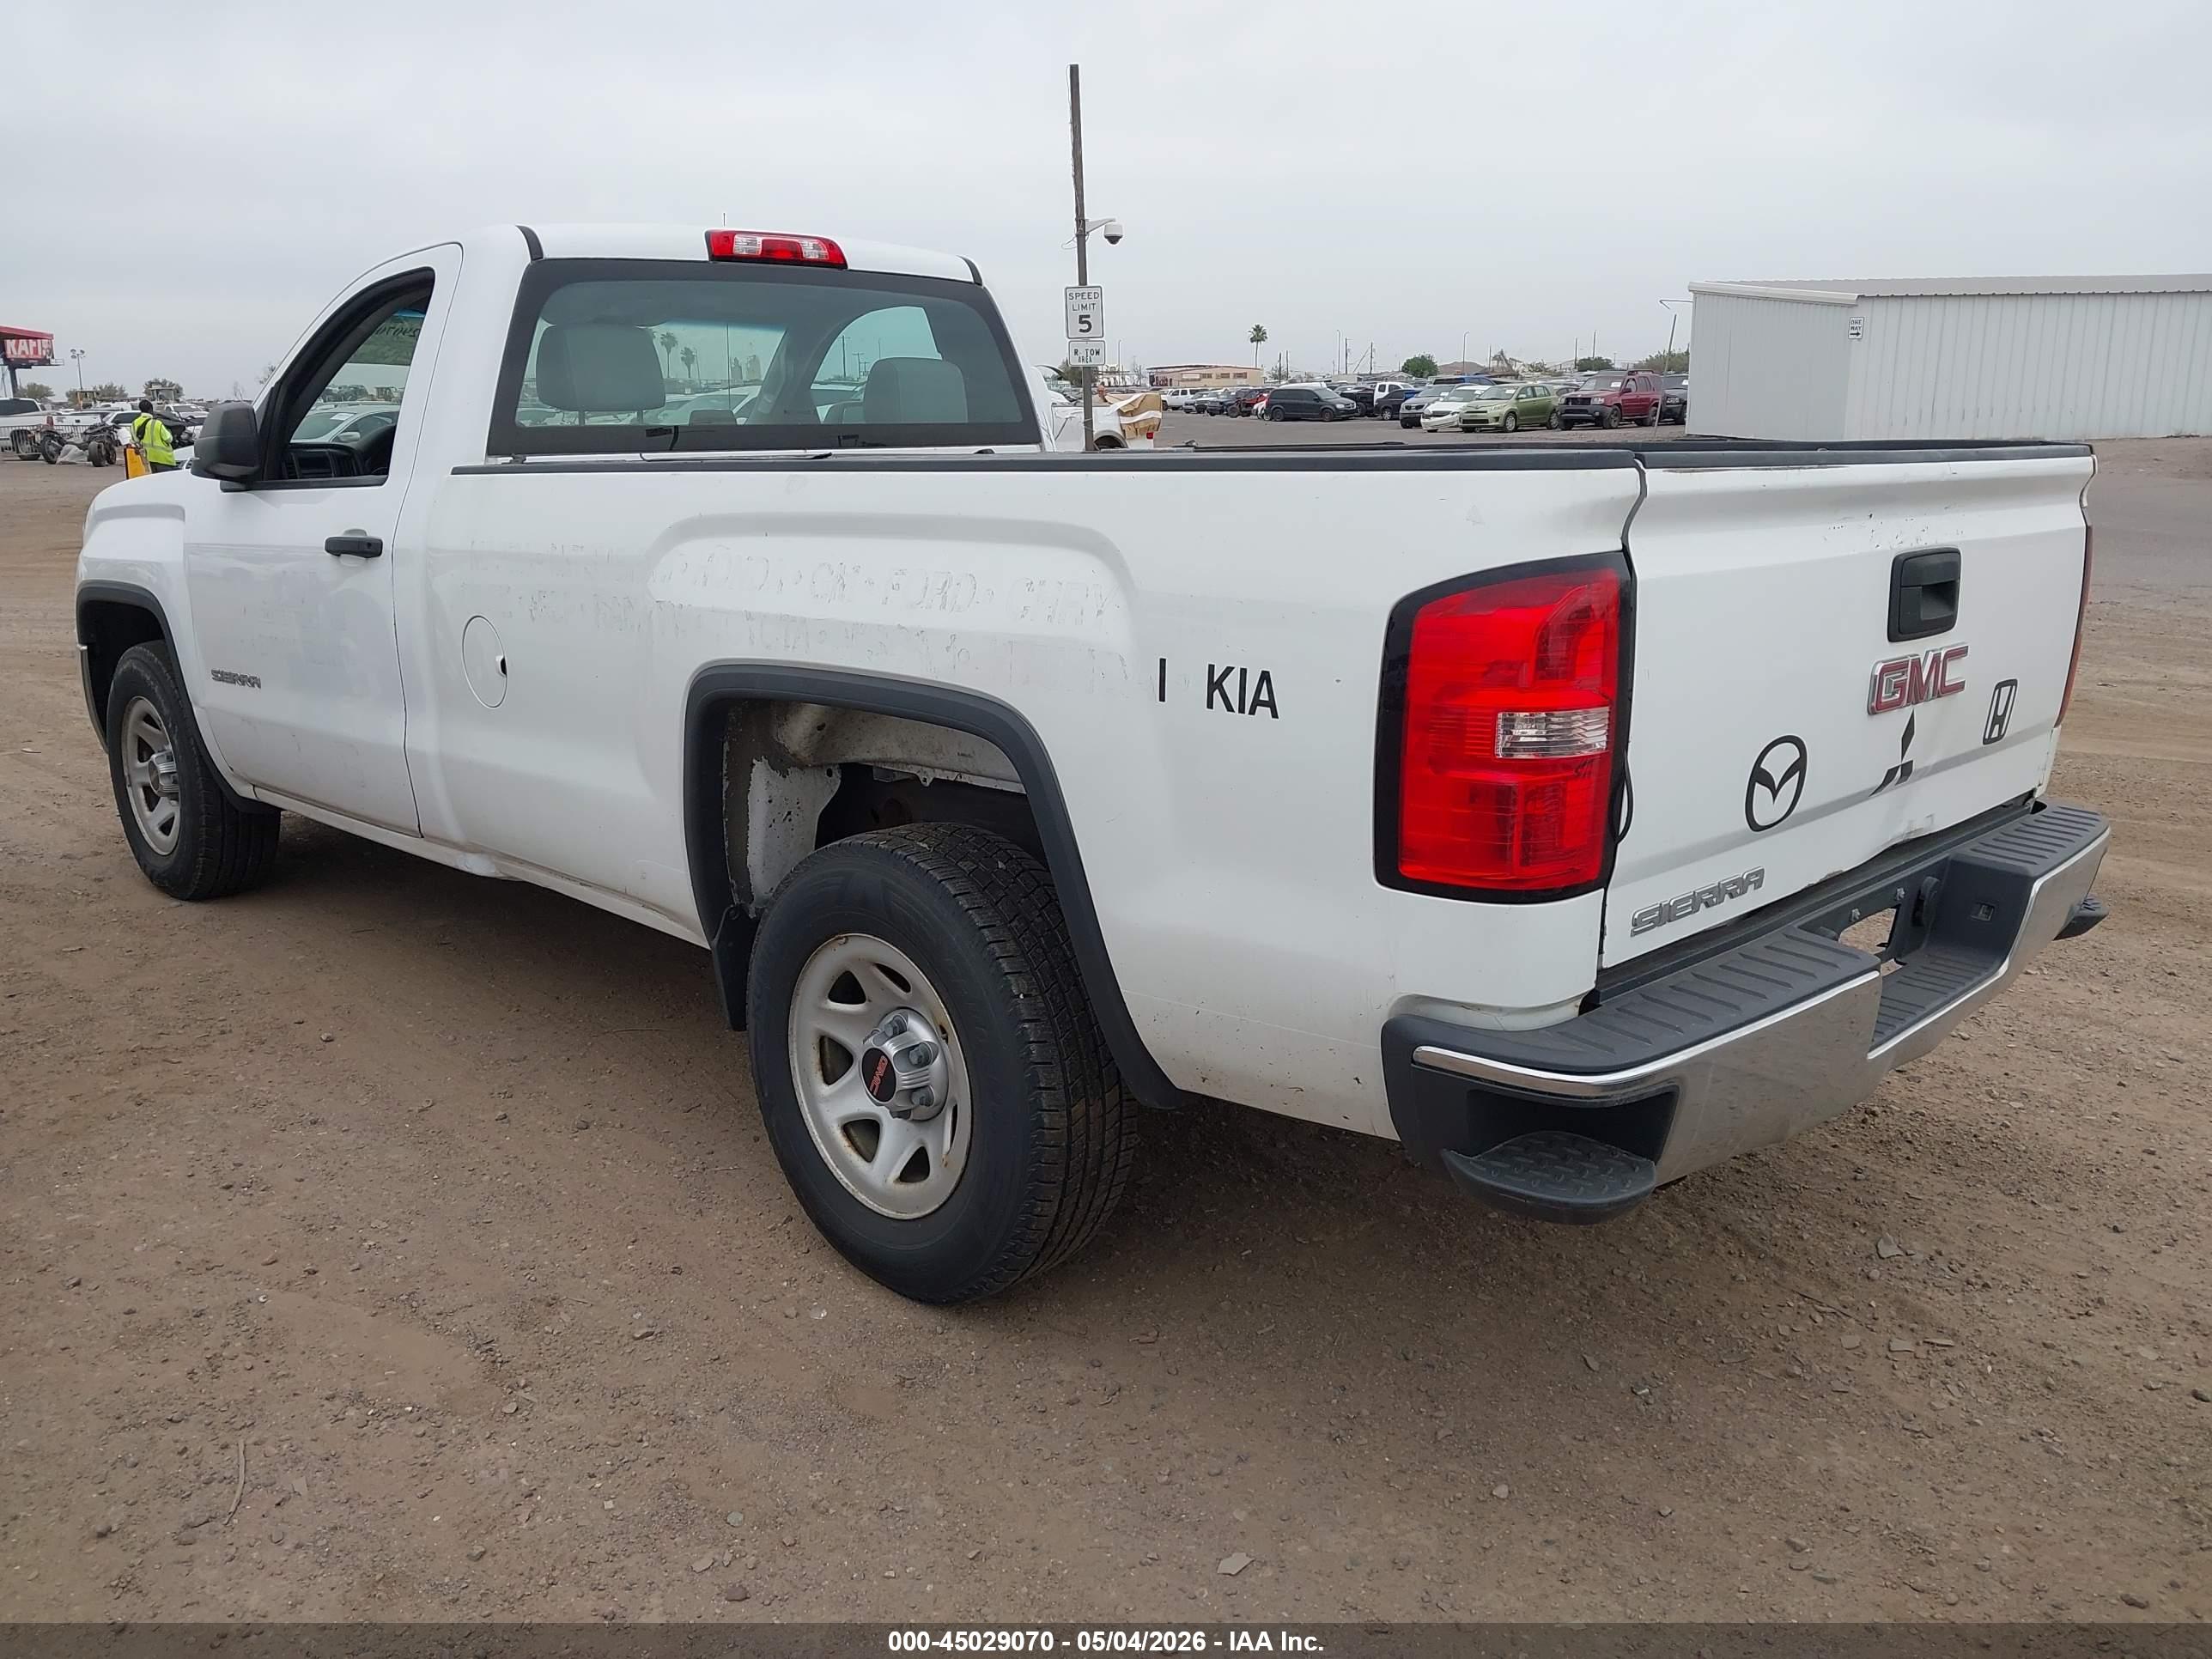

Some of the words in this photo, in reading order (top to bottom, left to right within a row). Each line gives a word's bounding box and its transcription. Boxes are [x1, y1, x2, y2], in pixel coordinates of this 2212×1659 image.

[1079, 314, 1092, 333] 5
[211, 669, 261, 689] SIERRA
[1206, 664, 1280, 720] KIA
[1868, 643, 1969, 714] GMC
[1631, 866, 1765, 938] SIERRA
